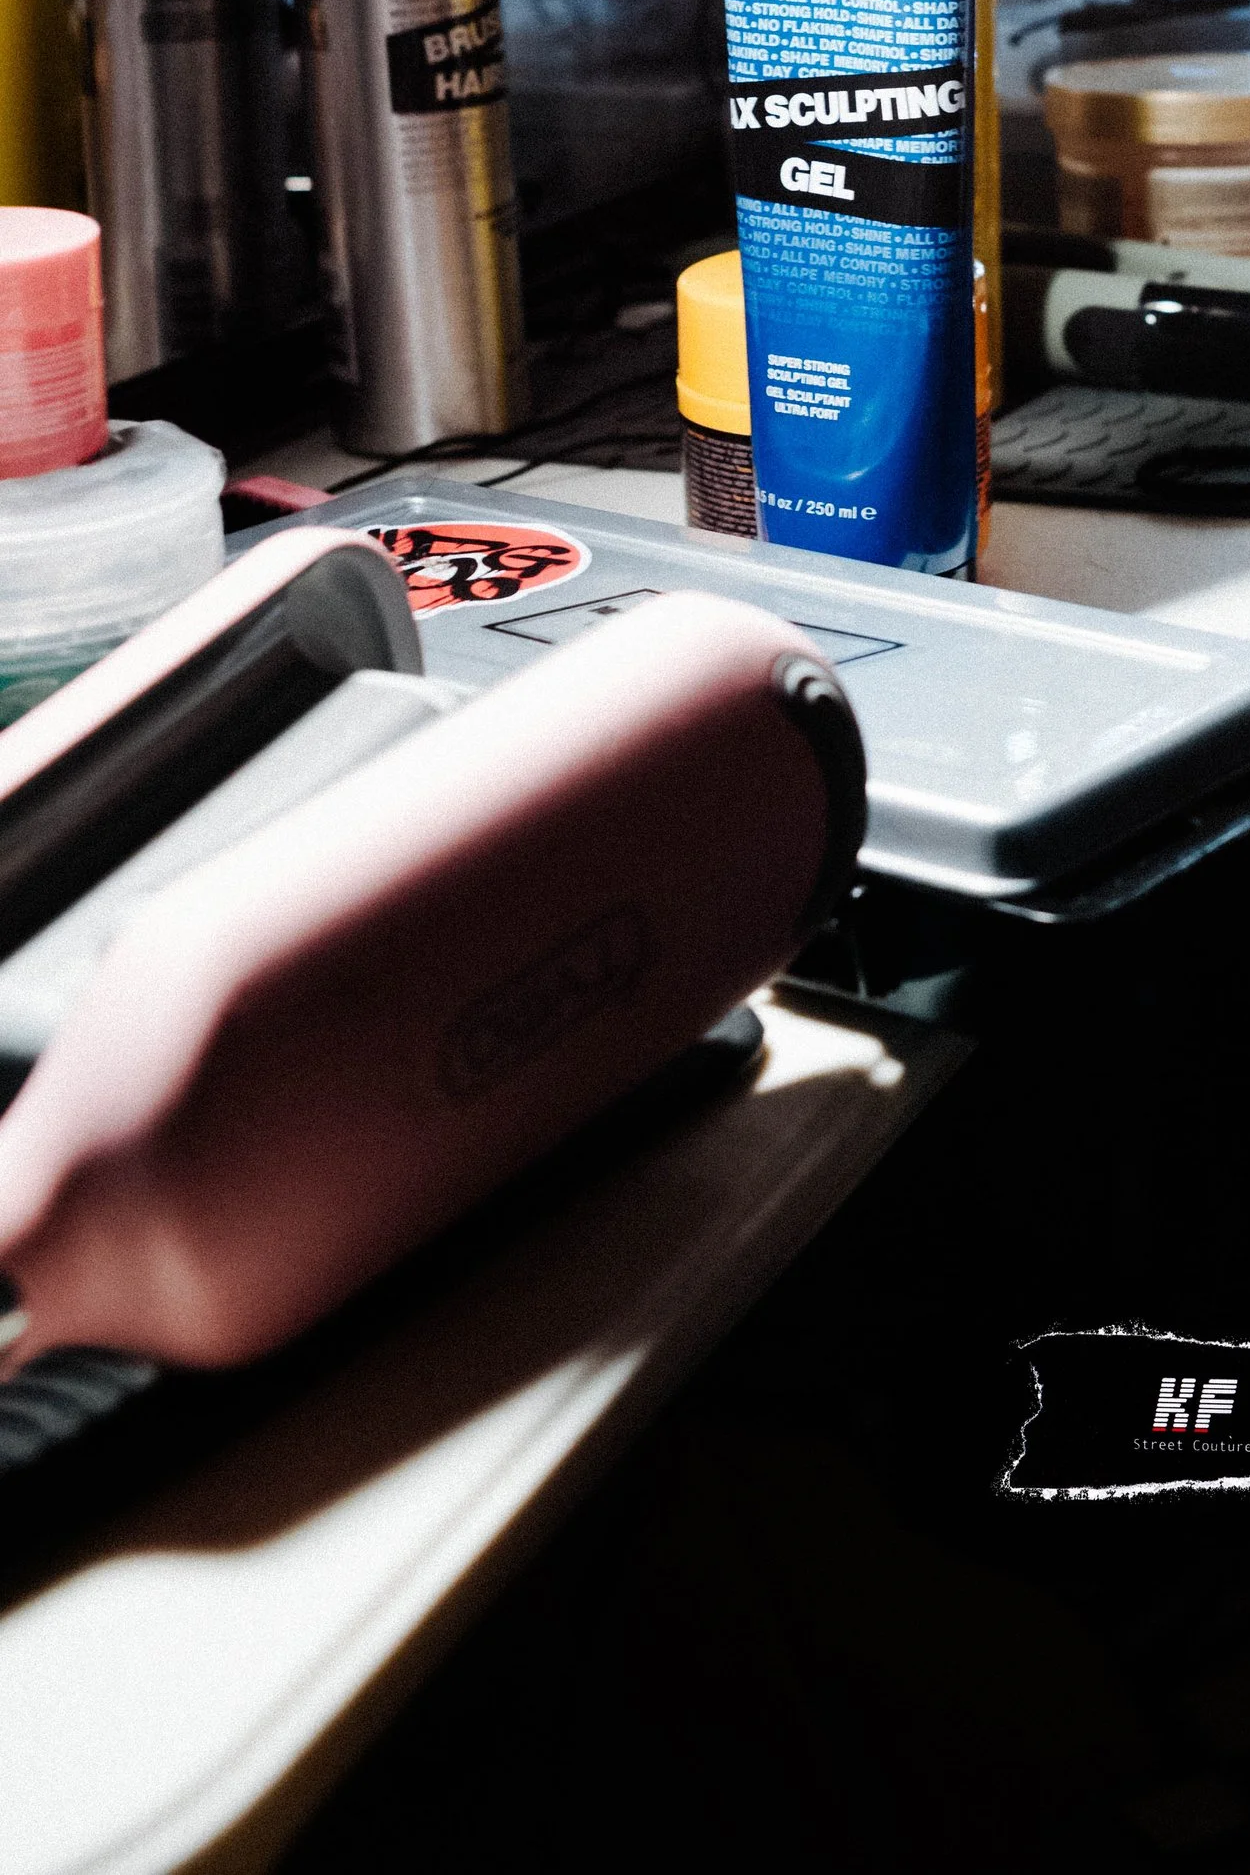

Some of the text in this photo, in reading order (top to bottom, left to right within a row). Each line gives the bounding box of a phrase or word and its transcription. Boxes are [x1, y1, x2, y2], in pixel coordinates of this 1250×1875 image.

[752, 3, 811, 19] STRONG
[814, 7, 850, 22] HOLD
[857, 12, 893, 27] SHINE
[903, 17, 934, 30] ALL
[758, 18, 780, 31] NO
[783, 21, 844, 36] FLAKING
[852, 27, 893, 43] SHAPE
[743, 32, 781, 46] HOLD
[790, 35, 817, 49] ALL
[820, 37, 846, 52] DAY
[848, 41, 910, 60] CONTROL
[736, 62, 758, 75] ALL
[763, 64, 792, 78] DAY
[780, 50, 830, 66] SHAPE
[834, 54, 889, 72] MEMORY
[764, 80, 966, 128] SCULPTING
[850, 138, 962, 153] SHAPE MEMOR
[780, 157, 855, 200] GEL
[772, 203, 798, 217] ALL
[803, 207, 831, 221] DAY
[749, 215, 802, 232] STRONG
[805, 224, 842, 237] HOLD
[851, 228, 891, 243] SHINE
[904, 232, 934, 245] ALL
[753, 231, 770, 245] NO
[774, 236, 835, 252] FLAKING
[845, 242, 891, 259] SHAPE
[781, 251, 804, 264] ALL
[809, 254, 837, 268] DAY
[840, 257, 908, 275] CONTROL
[771, 266, 818, 280] SHAPE
[824, 271, 886, 289] MEMORY
[768, 354, 851, 375] SUPER STRONG
[767, 368, 851, 390] SCULPTING GEL
[766, 386, 852, 408] GEL SCULPTANT
[774, 401, 840, 420] ULTRA FORT
[777, 499, 792, 510] oz
[806, 500, 835, 516] 250
[839, 506, 857, 519] ml
